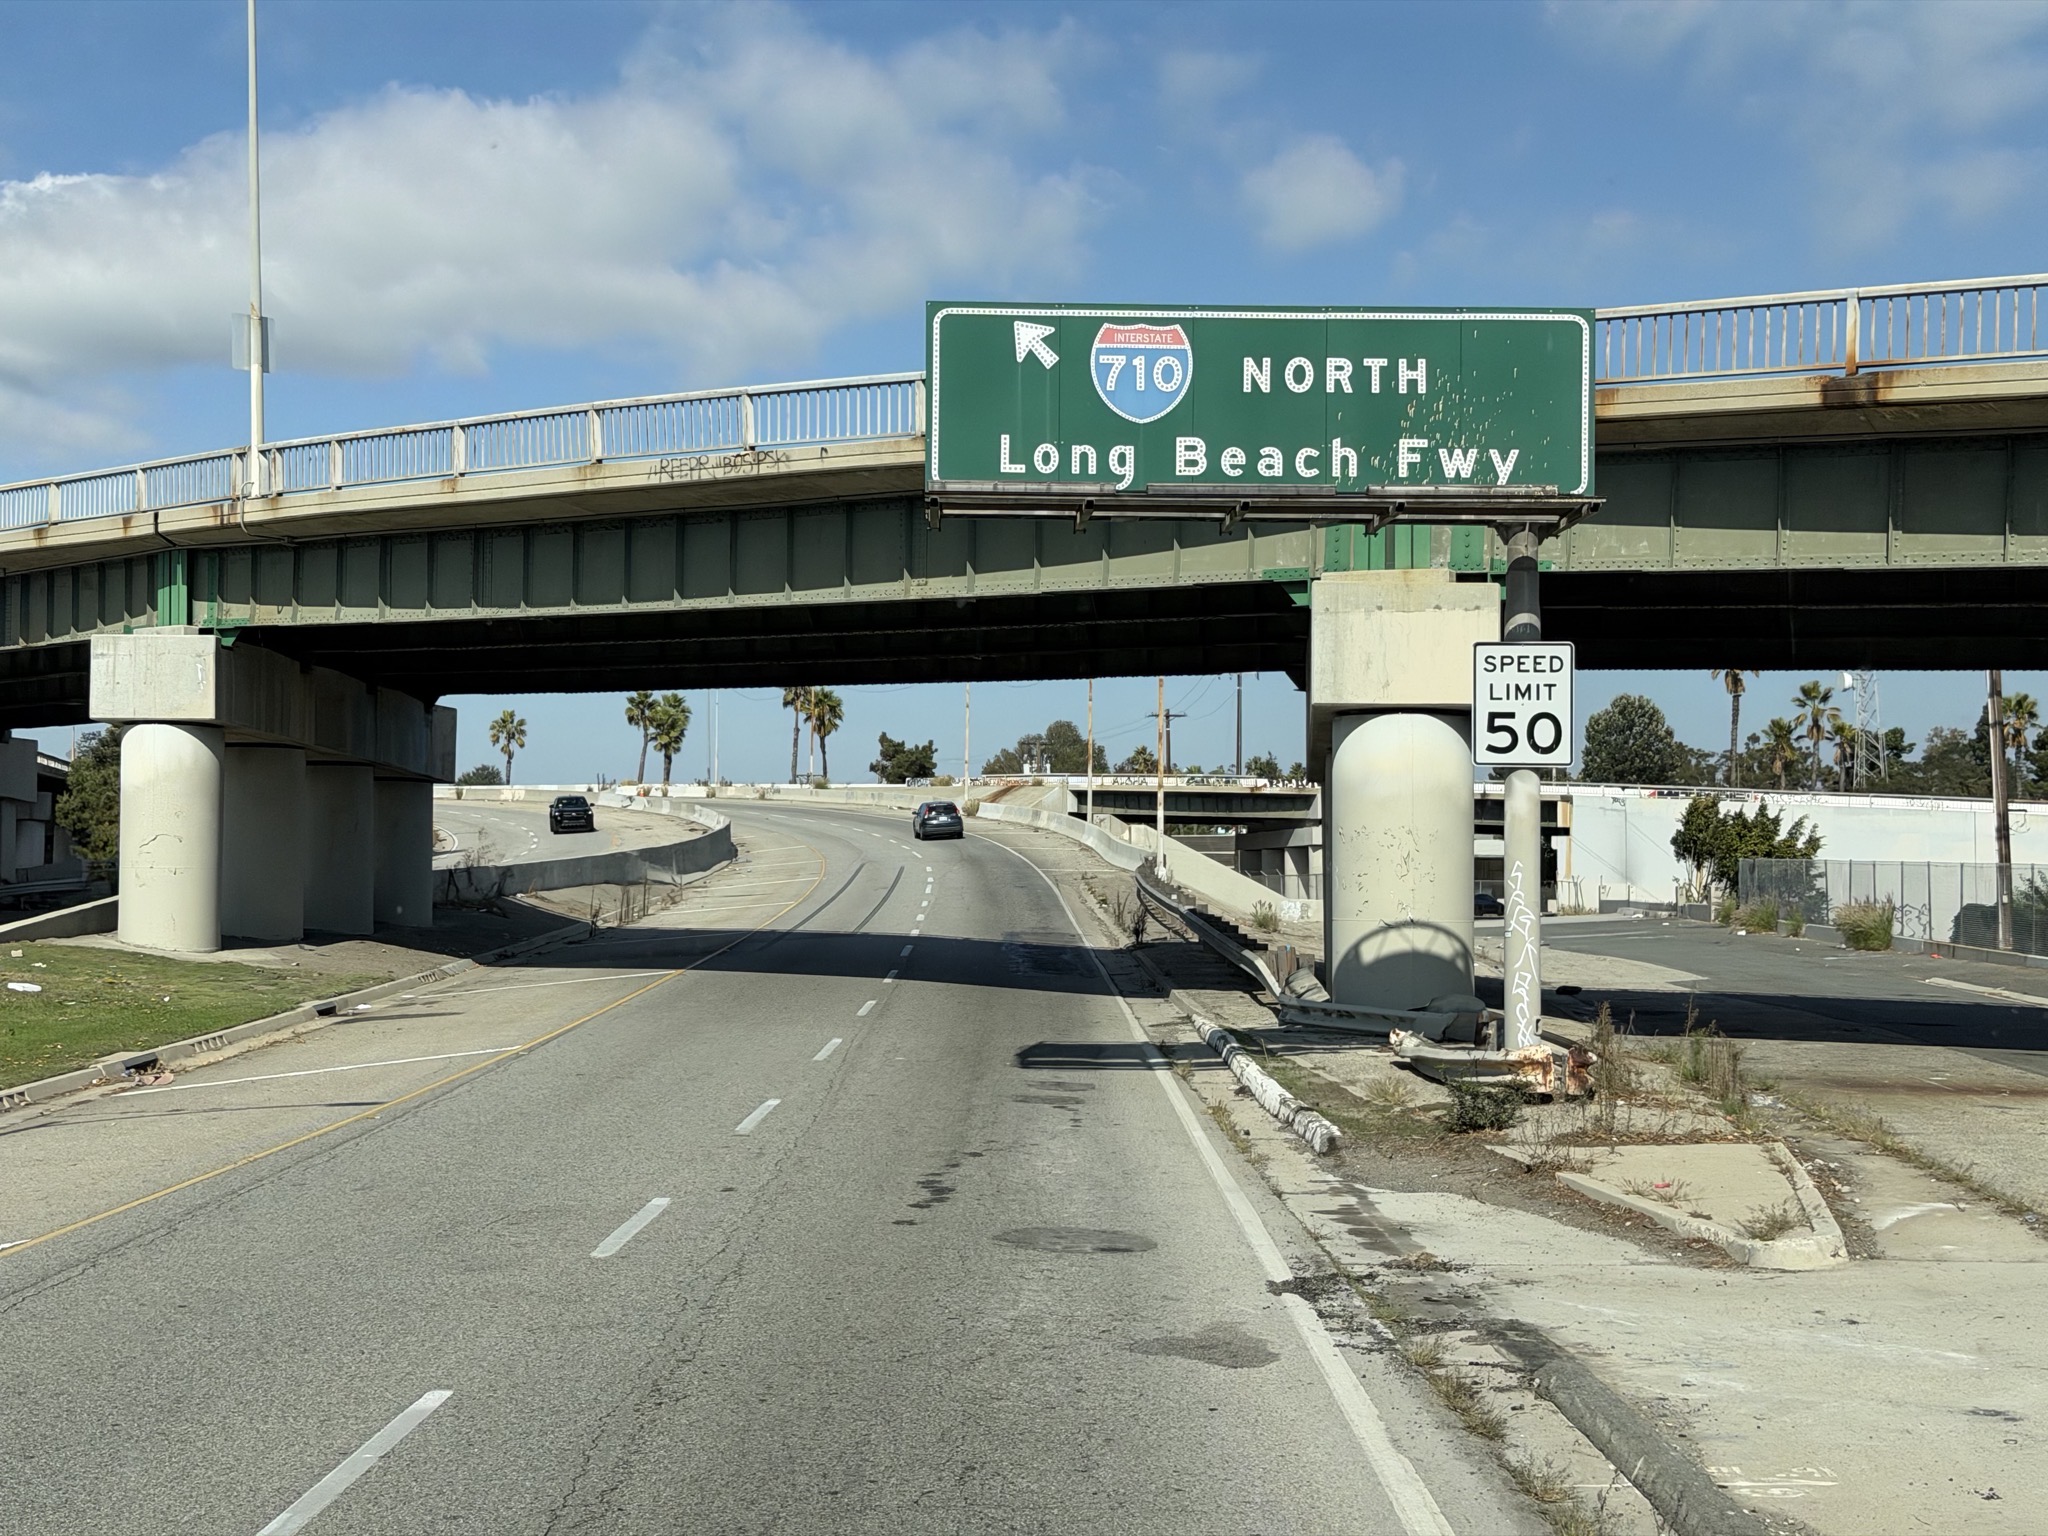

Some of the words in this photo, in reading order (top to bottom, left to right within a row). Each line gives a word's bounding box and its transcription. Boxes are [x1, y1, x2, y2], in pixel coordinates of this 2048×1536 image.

[1114, 332, 1174, 344] INTERSTATE
[1099, 355, 1183, 392] 710
[1243, 356, 1427, 394] NORTH
[1000, 434, 1135, 491] Long
[1175, 437, 1358, 477] Beach
[1398, 438, 1520, 486] Fwy
[1483, 655, 1564, 673] SPEED
[1489, 683, 1557, 701] LIMIT
[1485, 711, 1563, 755] 50
